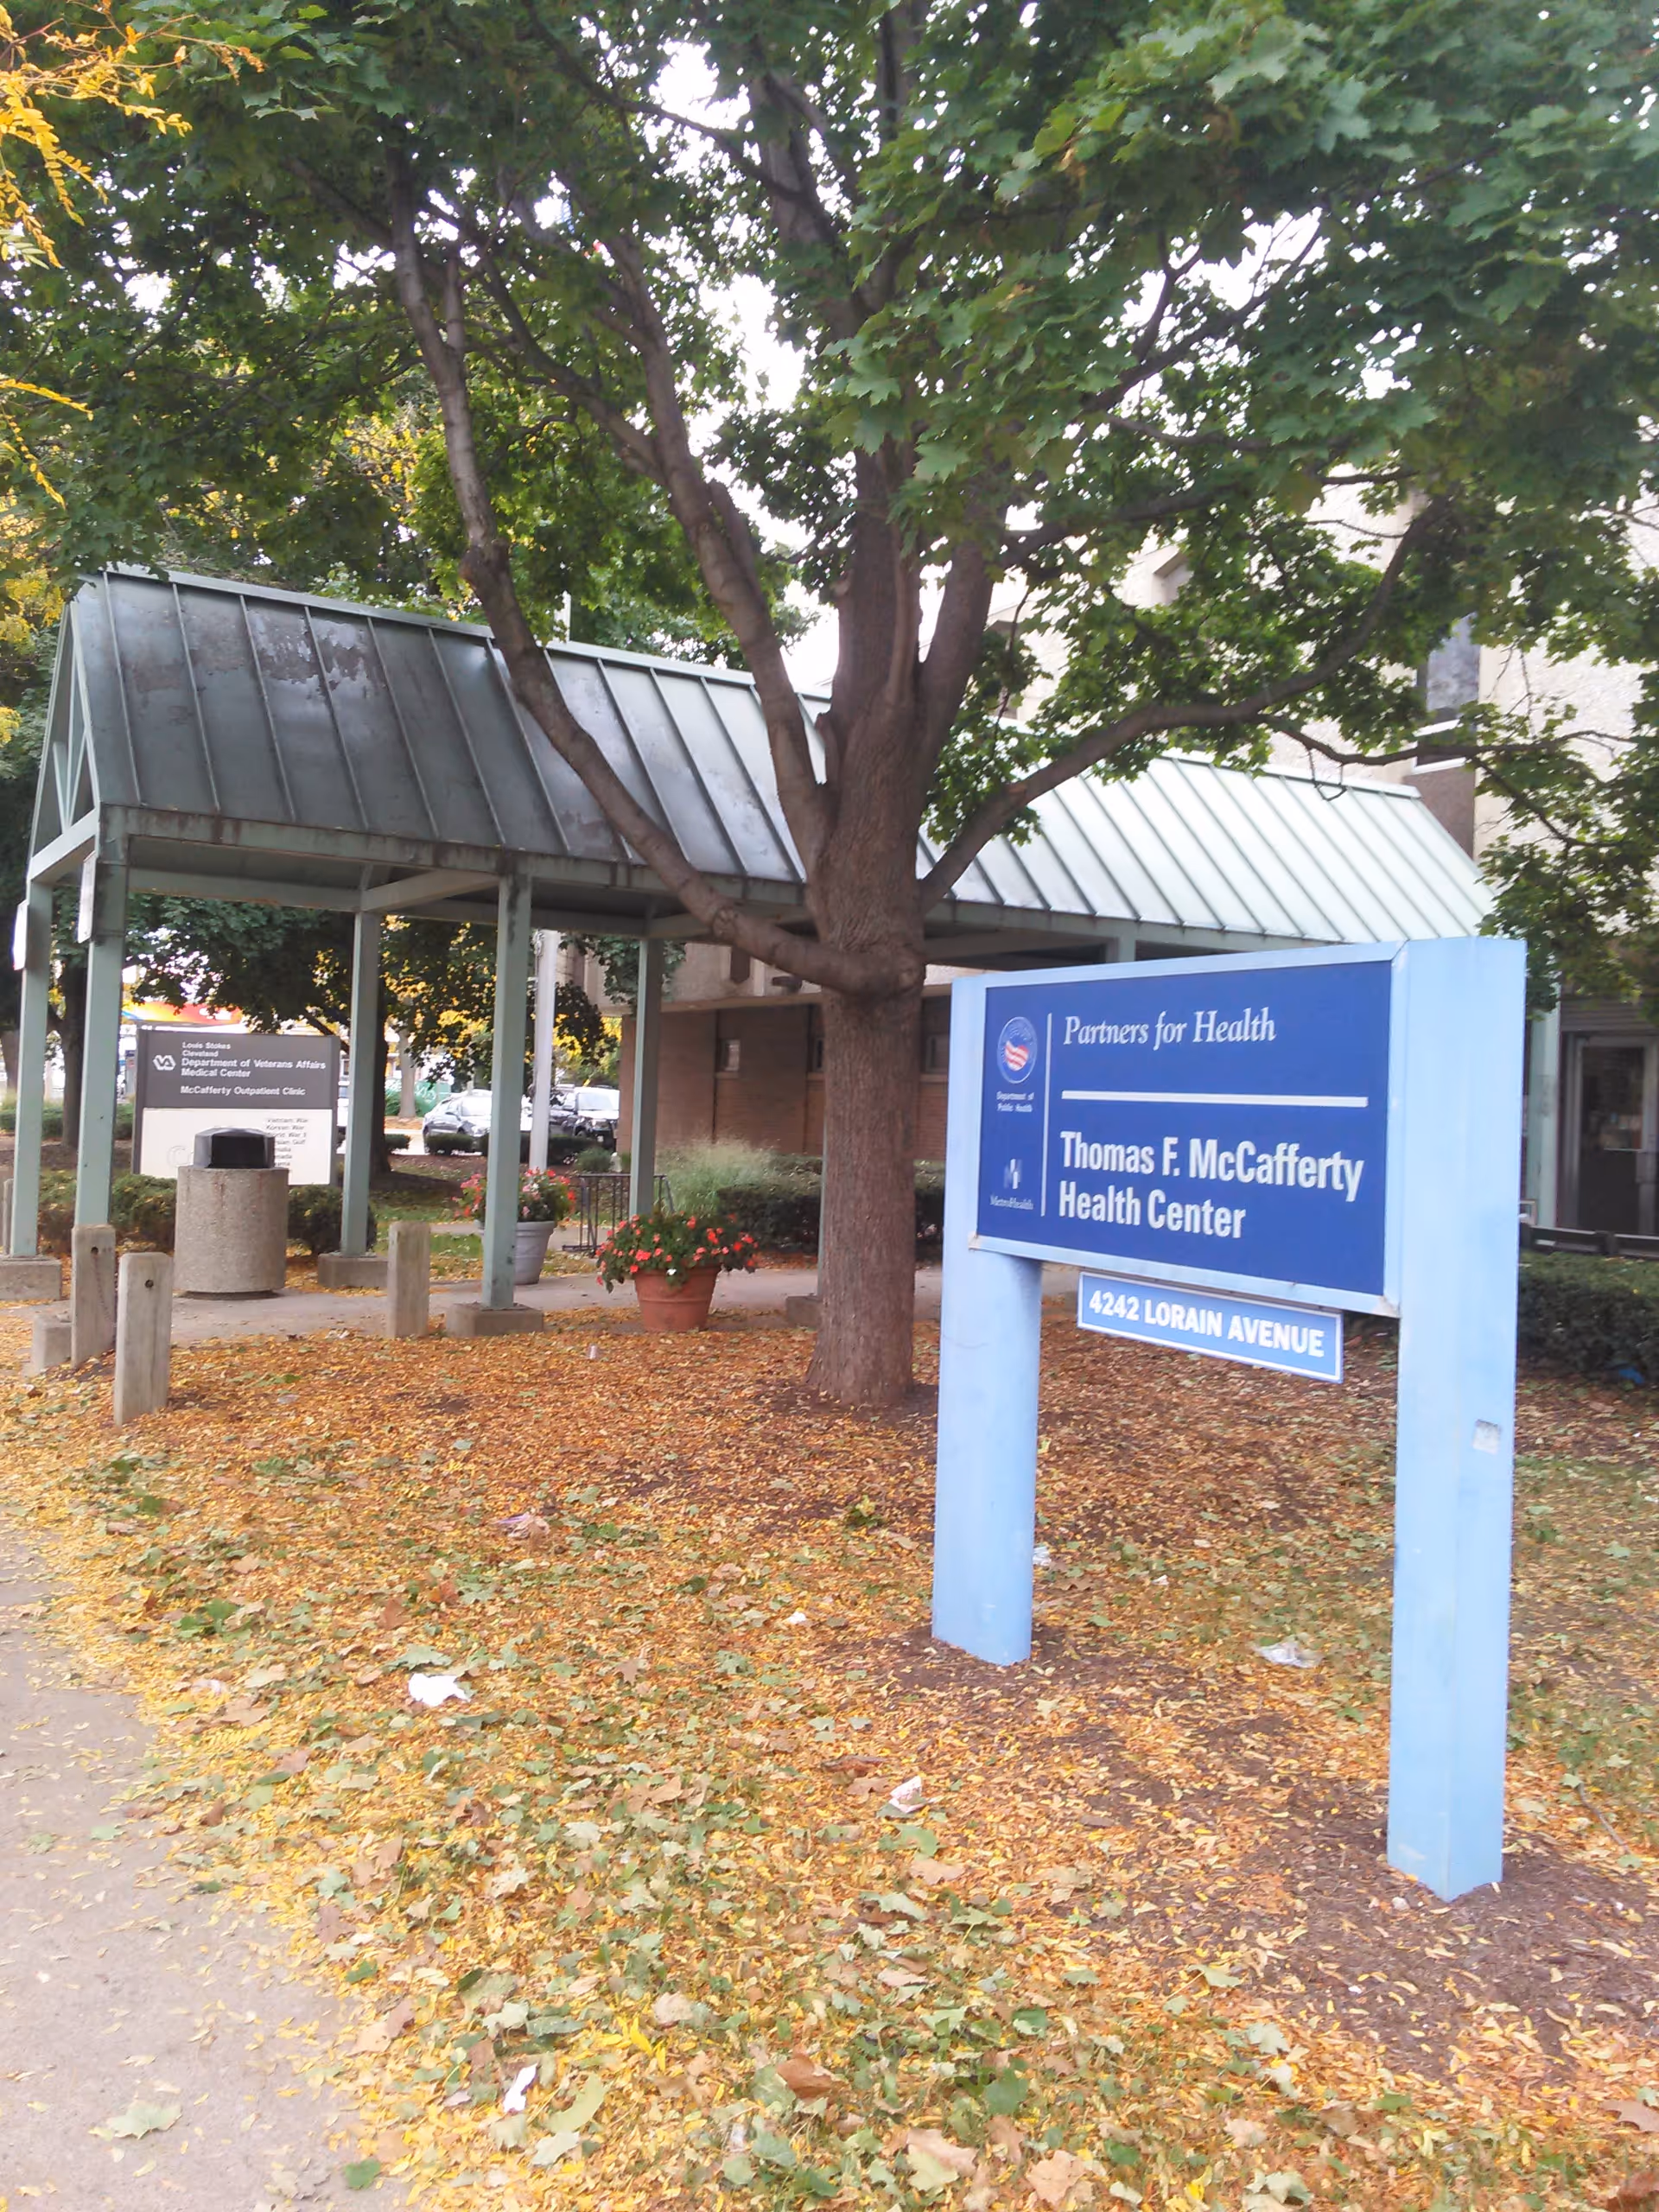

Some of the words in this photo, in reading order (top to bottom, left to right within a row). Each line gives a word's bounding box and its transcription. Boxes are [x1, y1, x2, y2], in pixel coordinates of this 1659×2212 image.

[1063, 1015, 1148, 1046] Partners
[1153, 1010, 1188, 1052] for
[1192, 1007, 1276, 1043] Health
[181, 1058, 237, 1069] Department
[239, 1059, 251, 1068] of
[254, 1059, 293, 1069] Veterans
[296, 1060, 326, 1070] Affairs
[181, 1069, 217, 1077] Medical
[220, 1069, 251, 1077] Center
[181, 1085, 231, 1096] McCafferty
[234, 1086, 281, 1096] Outpatient
[283, 1086, 306, 1096] Clinic
[1060, 1131, 1154, 1175] Thomas
[1161, 1136, 1180, 1178] F.
[1188, 1138, 1364, 1203] McCafferty
[1058, 1180, 1141, 1227] Health
[1147, 1188, 1246, 1238] Center
[1088, 1289, 1141, 1322] 4242
[1143, 1300, 1224, 1338] LORAIN
[1227, 1314, 1325, 1358] AVENUE
